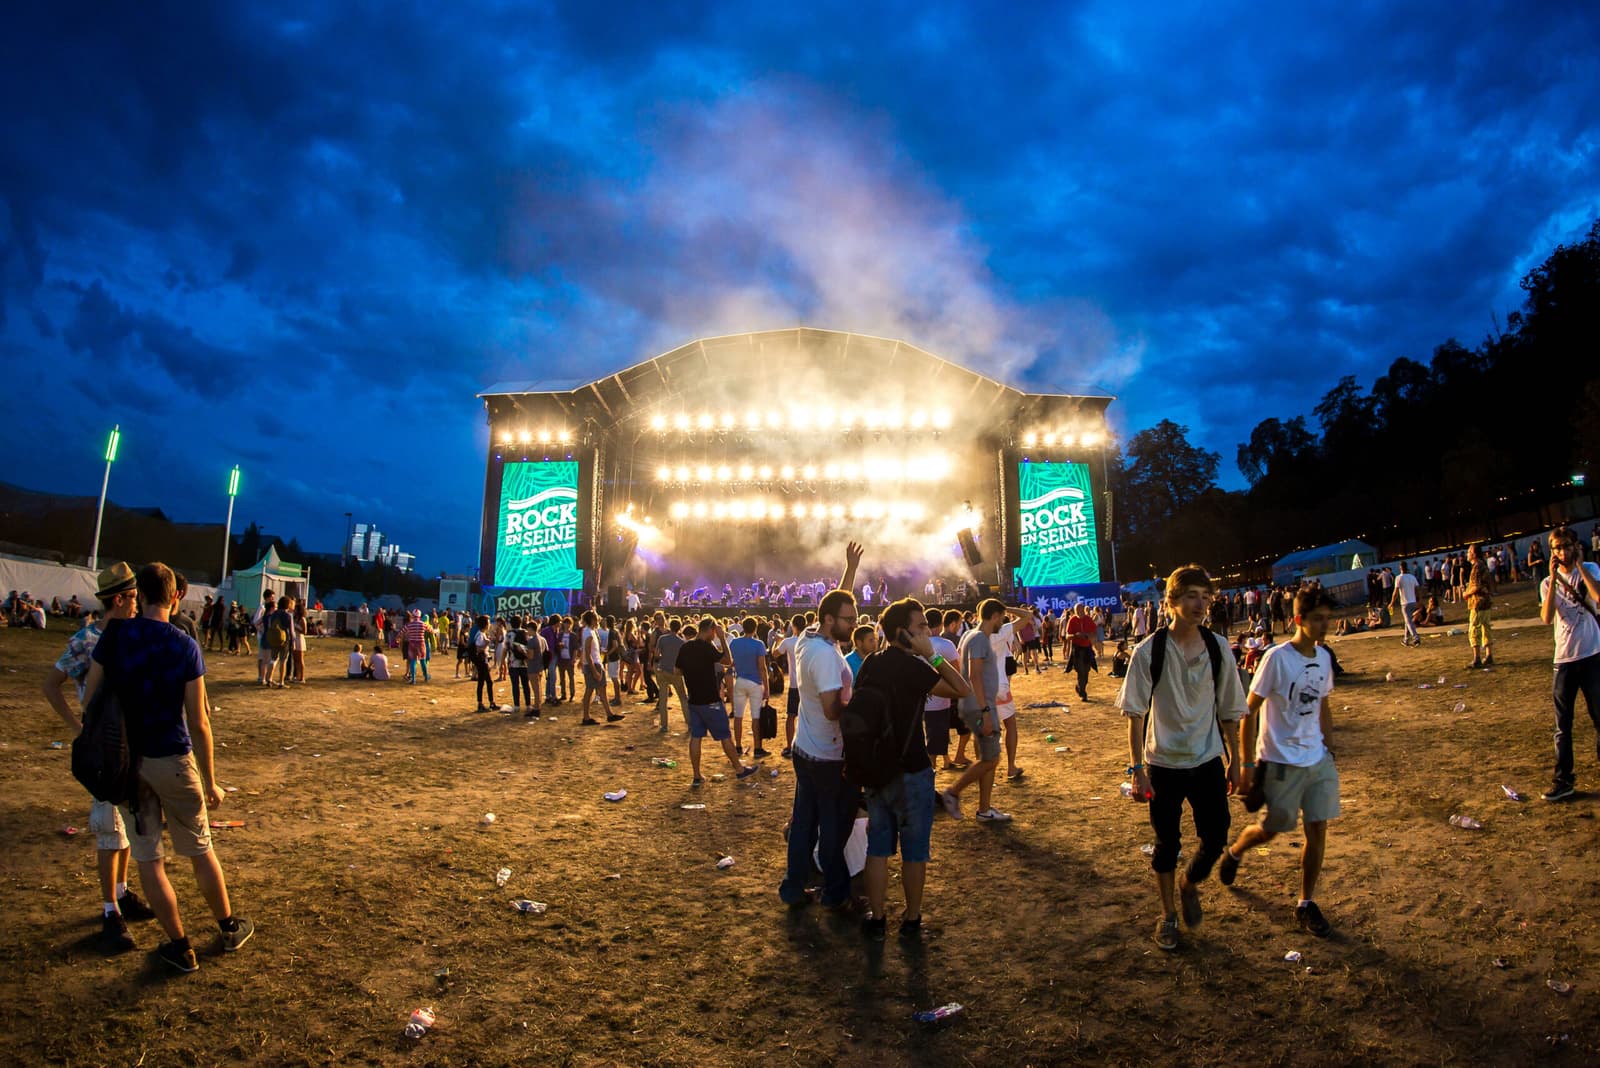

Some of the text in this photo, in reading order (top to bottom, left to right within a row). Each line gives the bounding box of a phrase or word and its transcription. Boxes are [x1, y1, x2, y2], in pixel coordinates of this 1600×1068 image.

[506, 502, 577, 535] ROCK
[1020, 502, 1086, 534] ROCK
[505, 524, 576, 547] EN SEINE
[1021, 534, 1037, 546] EN
[1038, 522, 1088, 547] SEINE
[497, 591, 542, 611] ROCK
